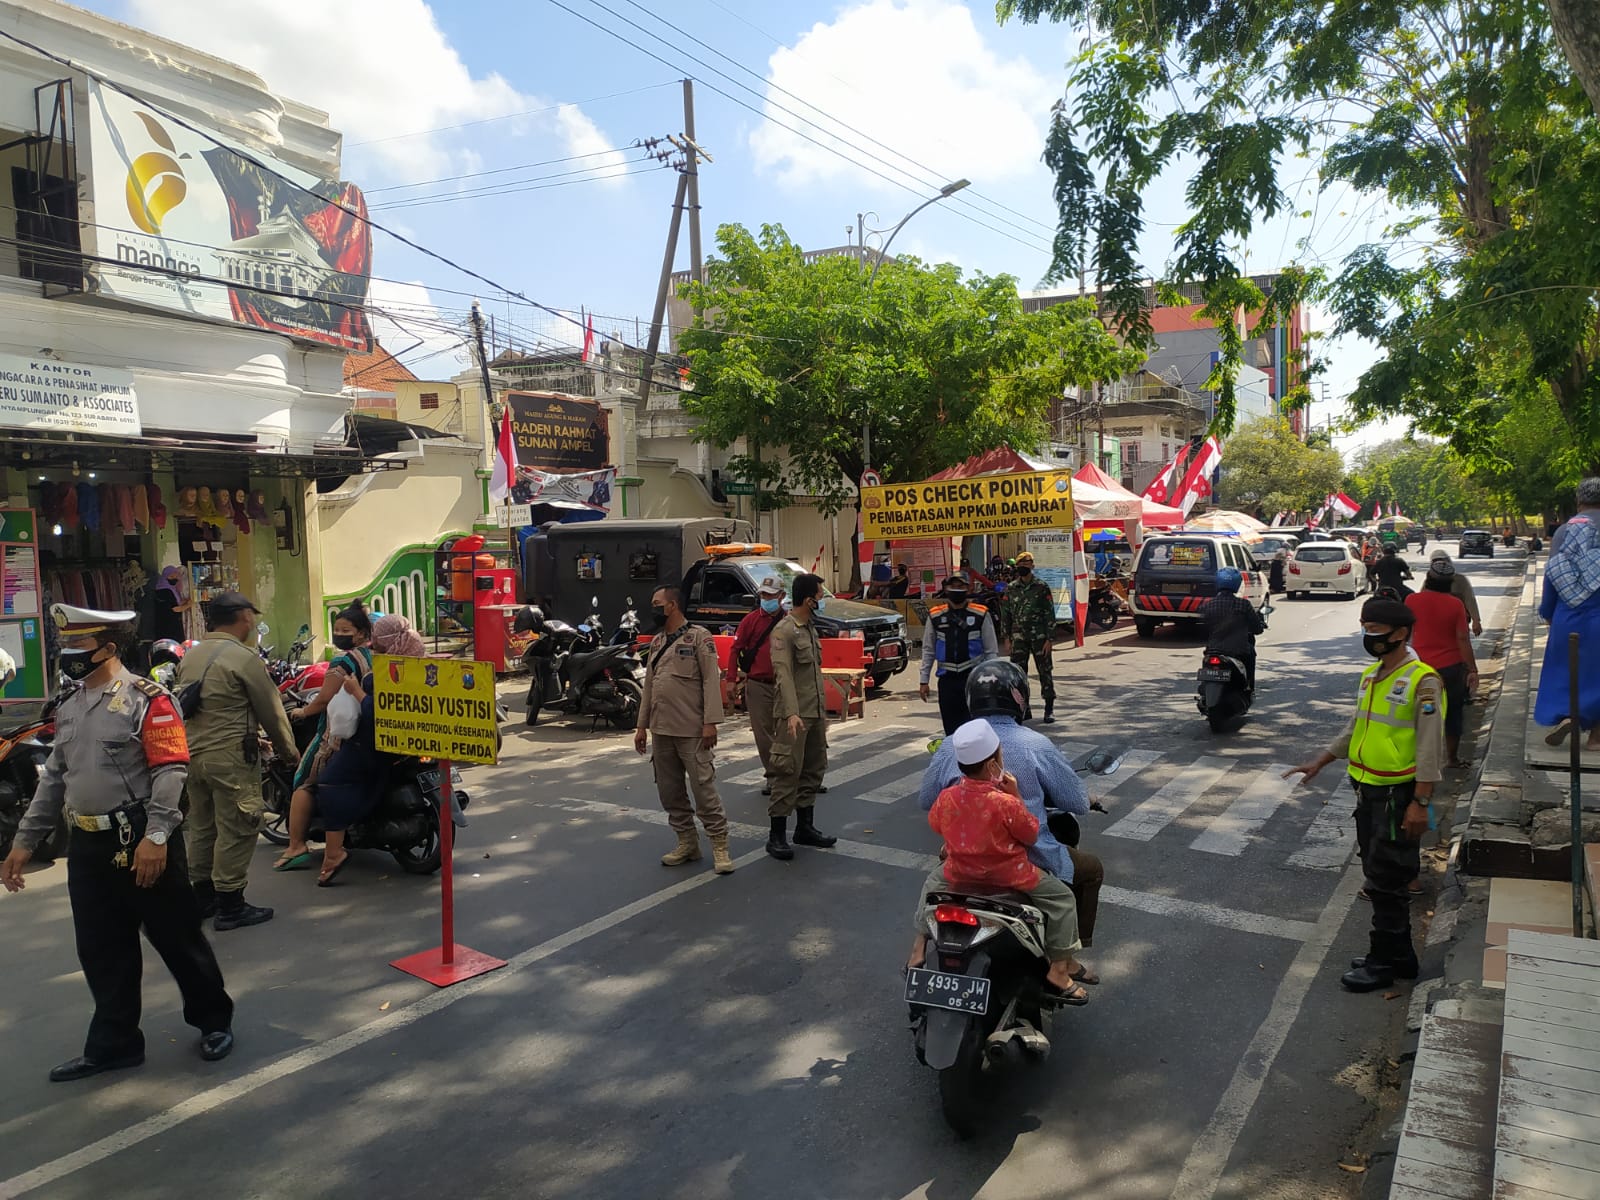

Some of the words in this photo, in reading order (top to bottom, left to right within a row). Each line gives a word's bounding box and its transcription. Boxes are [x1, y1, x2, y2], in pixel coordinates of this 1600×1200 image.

[30, 362, 92, 377] KANTOR
[45, 377, 51, 386] &
[53, 378, 98, 392] PENASIHAT
[100, 384, 131, 396] HUKUM
[21, 389, 70, 407] SUMANTO
[72, 397, 80, 407] &
[83, 397, 134, 413] ASSOCIATES
[512, 421, 551, 436] RADEN
[554, 423, 596, 439] RAHMAT
[518, 436, 557, 449] SUNAN
[560, 440, 594, 453] AMPEL
[884, 488, 918, 507] POS
[923, 483, 983, 504] CHECK
[989, 477, 1046, 498] POINT
[869, 508, 954, 524] PEMBATASAN
[958, 503, 997, 519] PPKM
[1001, 497, 1068, 515] DARURAT
[880, 524, 914, 535] POLRES
[916, 522, 971, 534] PELABUHAN
[974, 518, 1018, 529] TANJUNG
[1020, 515, 1053, 526] PERAK
[377, 692, 433, 714] OPERASI
[437, 697, 491, 720] YUSTISI
[375, 718, 415, 731] PENEGAKAN
[416, 722, 451, 735] PROTOKOL
[454, 725, 495, 739] KESEHATAN
[379, 734, 398, 747] TNI
[407, 737, 441, 752] POLRI
[451, 742, 493, 759] PEMDA
[910, 971, 919, 986] L
[927, 974, 960, 991] 4935
[967, 980, 986, 996] JW
